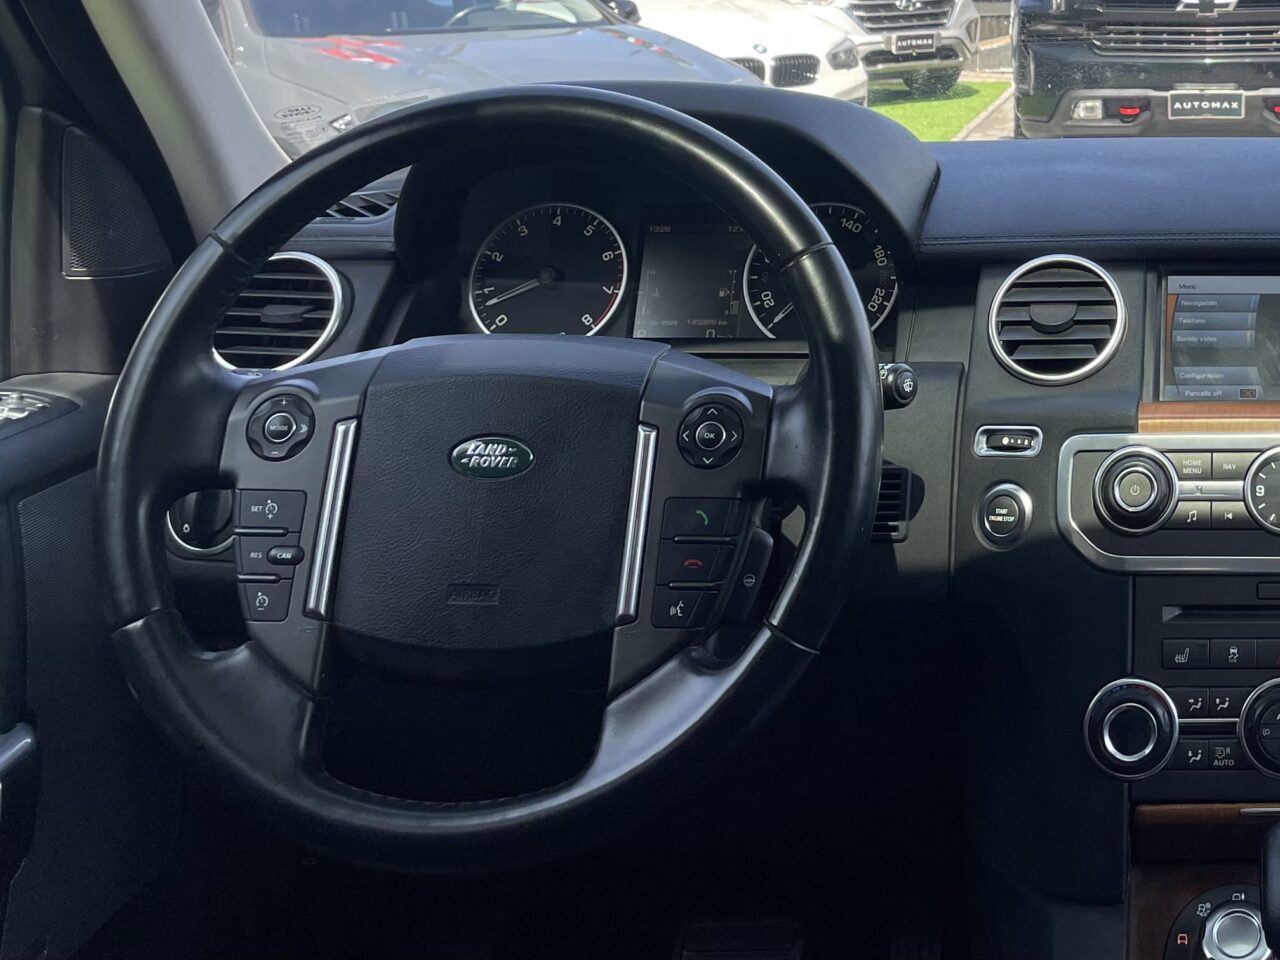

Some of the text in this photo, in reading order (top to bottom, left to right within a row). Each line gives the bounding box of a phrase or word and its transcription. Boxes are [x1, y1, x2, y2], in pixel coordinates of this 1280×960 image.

[1173, 101, 1239, 109] AUTOMAX
[553, 216, 562, 227] 4
[840, 218, 862, 233] 140
[518, 225, 529, 237] 3
[584, 225, 596, 236] 5
[491, 251, 504, 262] 2
[602, 251, 614, 261] 6
[873, 245, 888, 266] 180
[483, 286, 495, 294] 1
[602, 285, 614, 295] 7
[761, 291, 775, 308] 20
[867, 288, 885, 312] 220
[495, 314, 508, 326] 0
[581, 314, 593, 325] 8
[466, 443, 508, 455] LAND
[468, 456, 519, 468] ROVER
[1255, 485, 1265, 497] 9
[1213, 759, 1235, 767] AUTO
